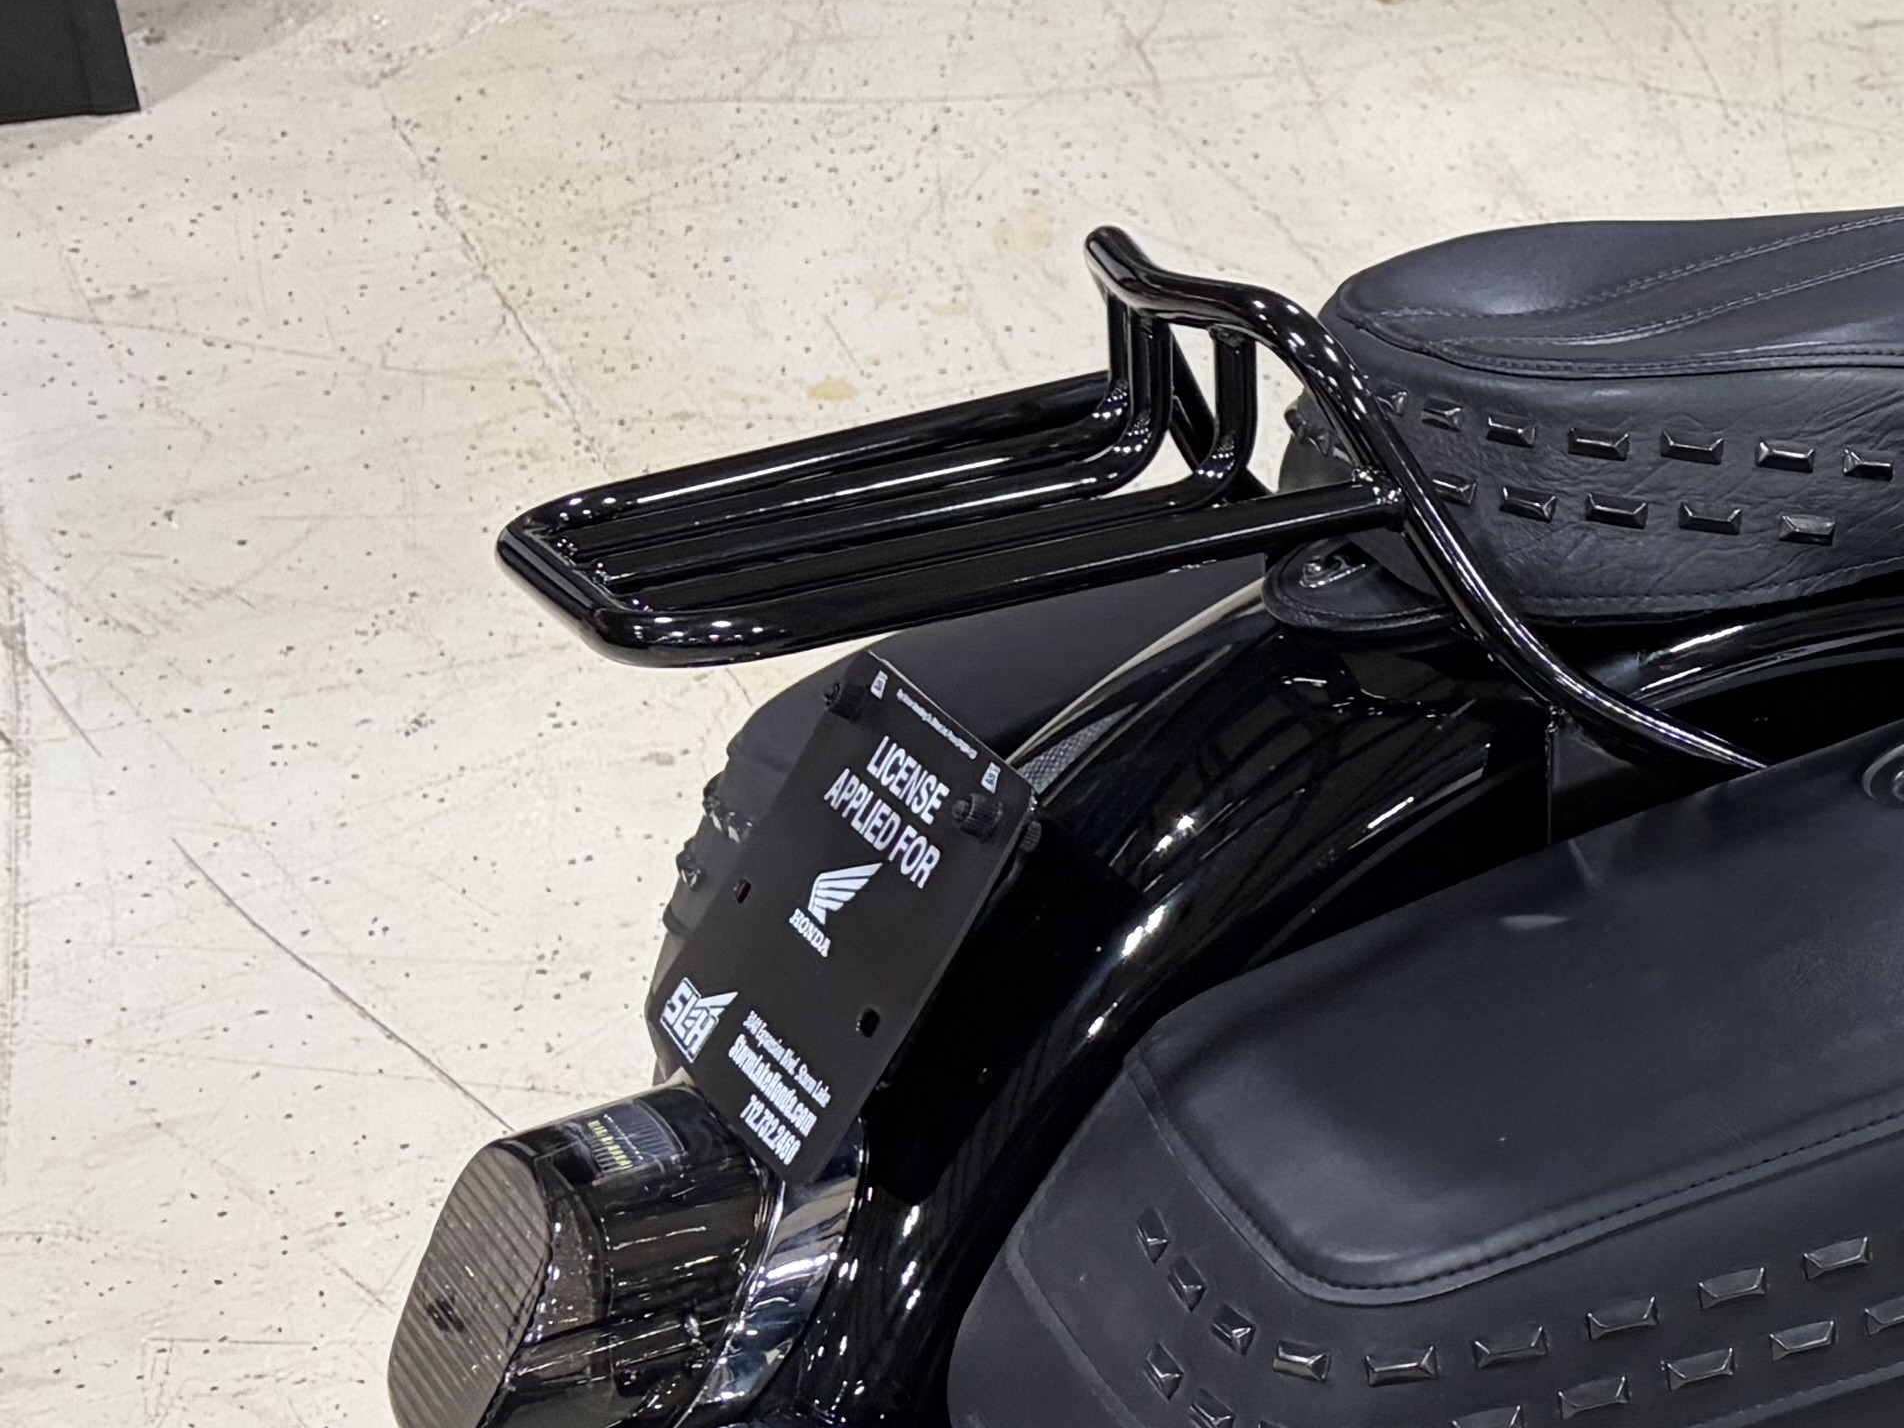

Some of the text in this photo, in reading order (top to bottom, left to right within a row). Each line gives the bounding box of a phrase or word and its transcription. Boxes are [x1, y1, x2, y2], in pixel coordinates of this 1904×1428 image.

[866, 735, 951, 826] LICENSE
[823, 768, 903, 852] APPLIED
[887, 823, 942, 890] FOR
[788, 907, 832, 959] HONDA
[728, 1033, 818, 1139] StormLakeHonda.com
[811, 1079, 832, 1109] Lake
[739, 1093, 803, 1166] 712.732.2460
